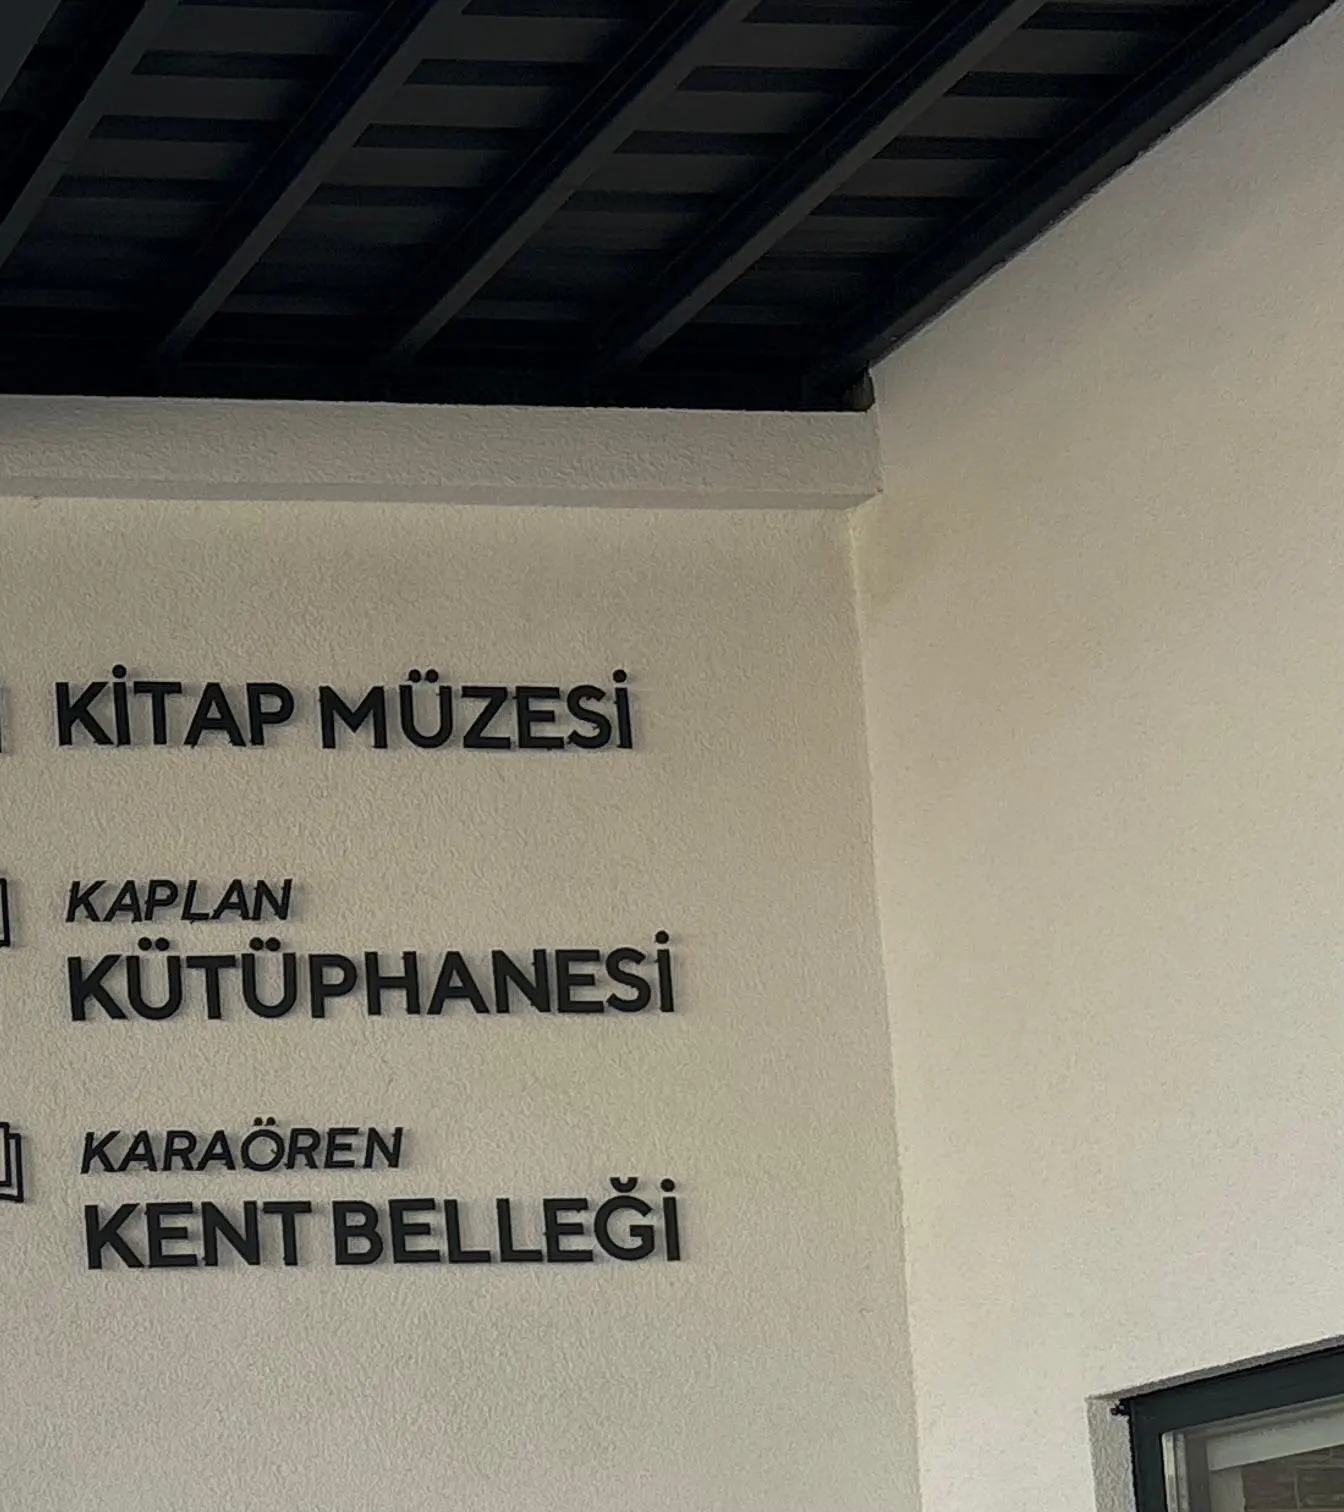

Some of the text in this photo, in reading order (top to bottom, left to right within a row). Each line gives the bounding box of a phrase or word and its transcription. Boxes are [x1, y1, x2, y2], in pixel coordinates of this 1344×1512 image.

[56, 665, 634, 750] KİTAP MÜZESİ
[66, 879, 293, 923] KAPLAN
[68, 930, 676, 1022] KÜTÜPHANESİ
[81, 1117, 404, 1175] KARAÖREN
[84, 1176, 682, 1270] KENT BELLEĞİ
